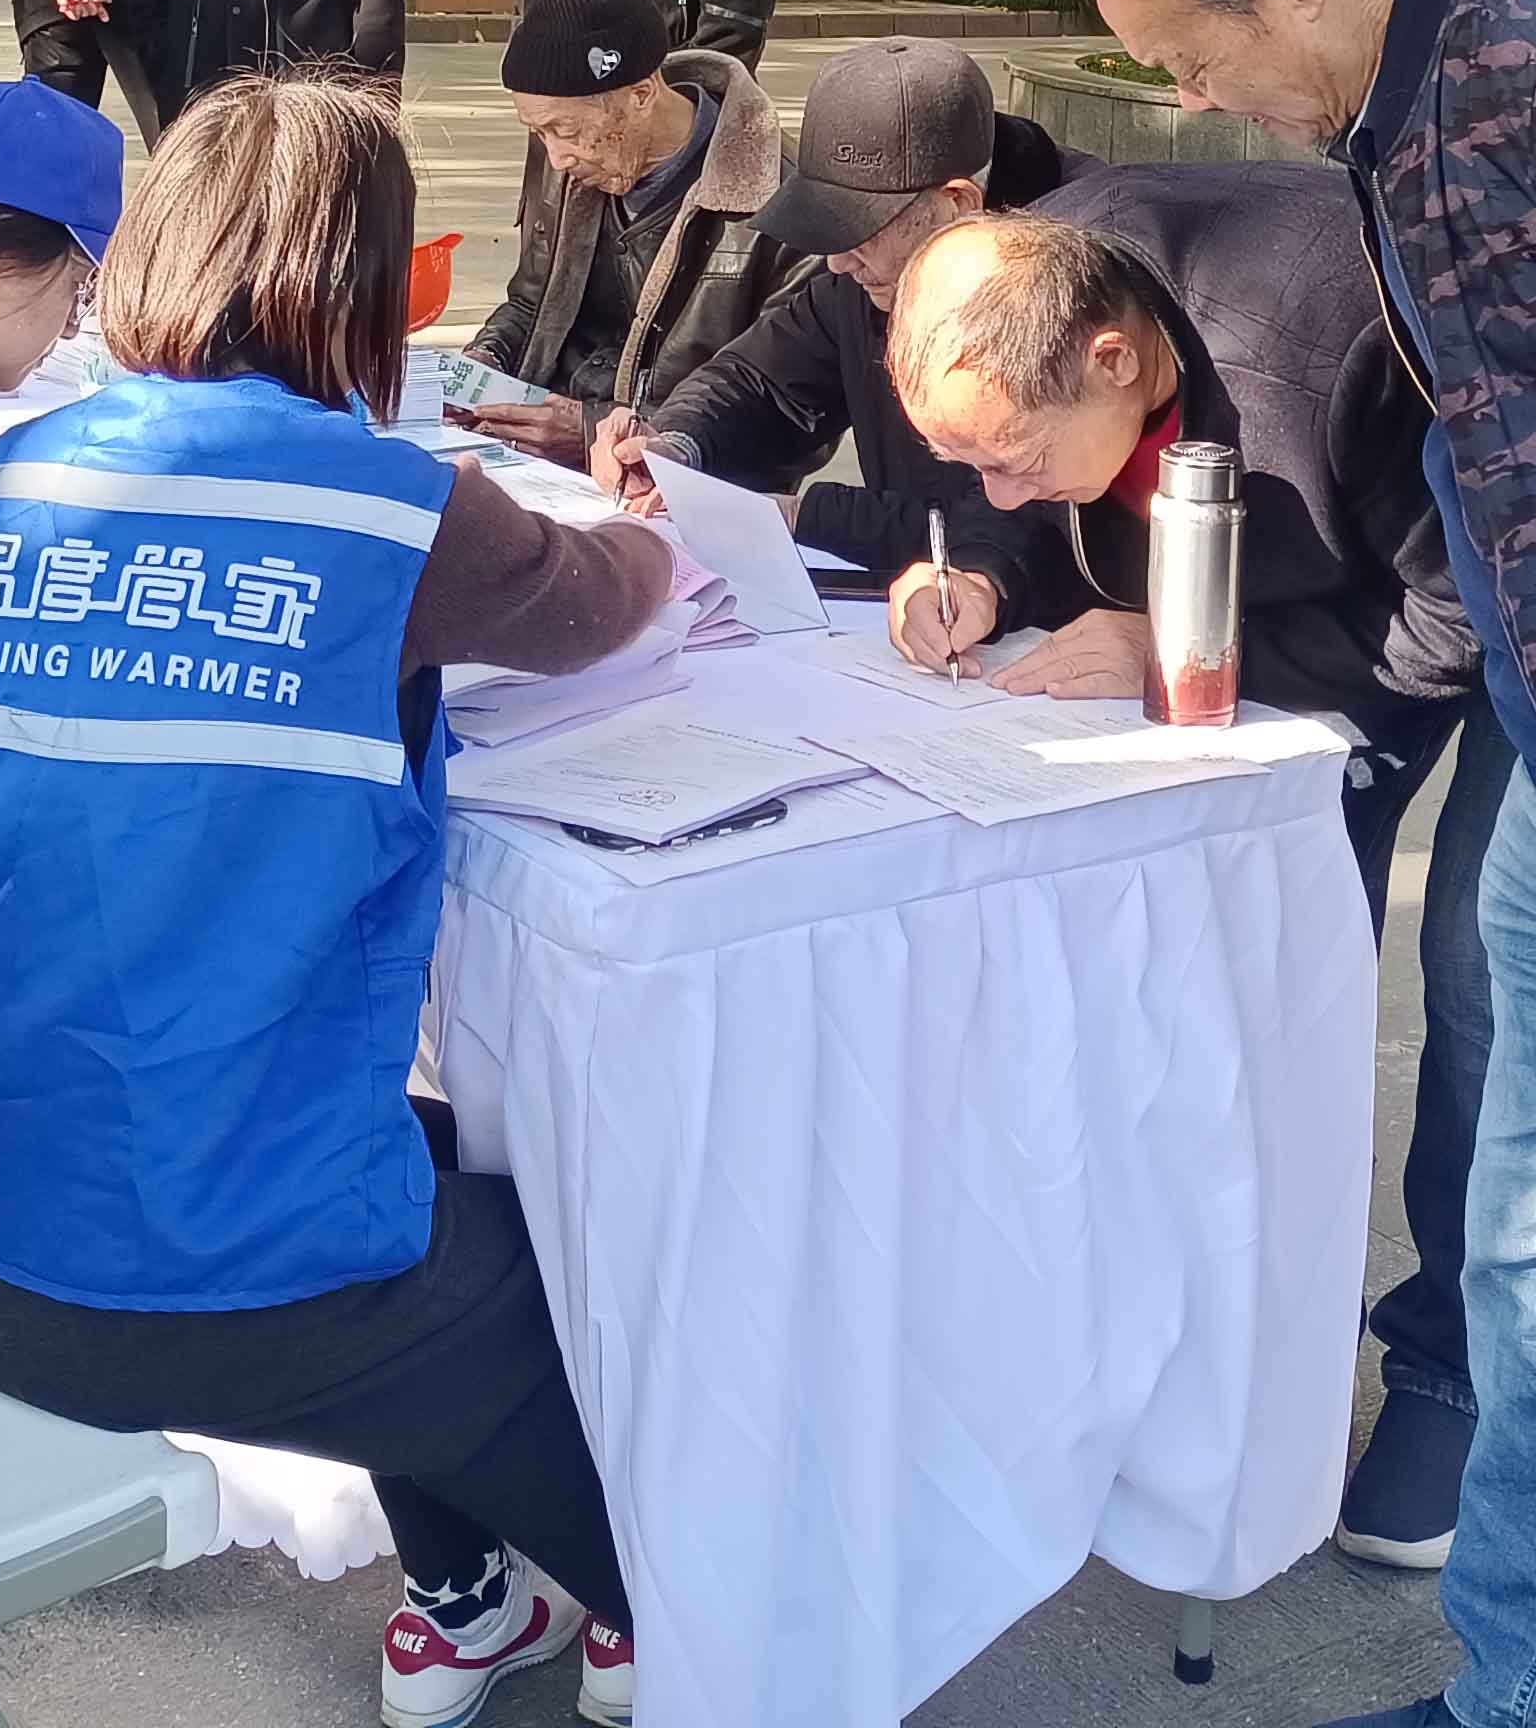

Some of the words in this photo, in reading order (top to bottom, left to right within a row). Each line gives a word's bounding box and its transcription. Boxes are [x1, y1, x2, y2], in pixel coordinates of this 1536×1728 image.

[832, 144, 884, 169] Sport
[90, 647, 303, 707] WARMER
[392, 1628, 428, 1655] NIKE
[589, 1621, 621, 1651] NIKE
